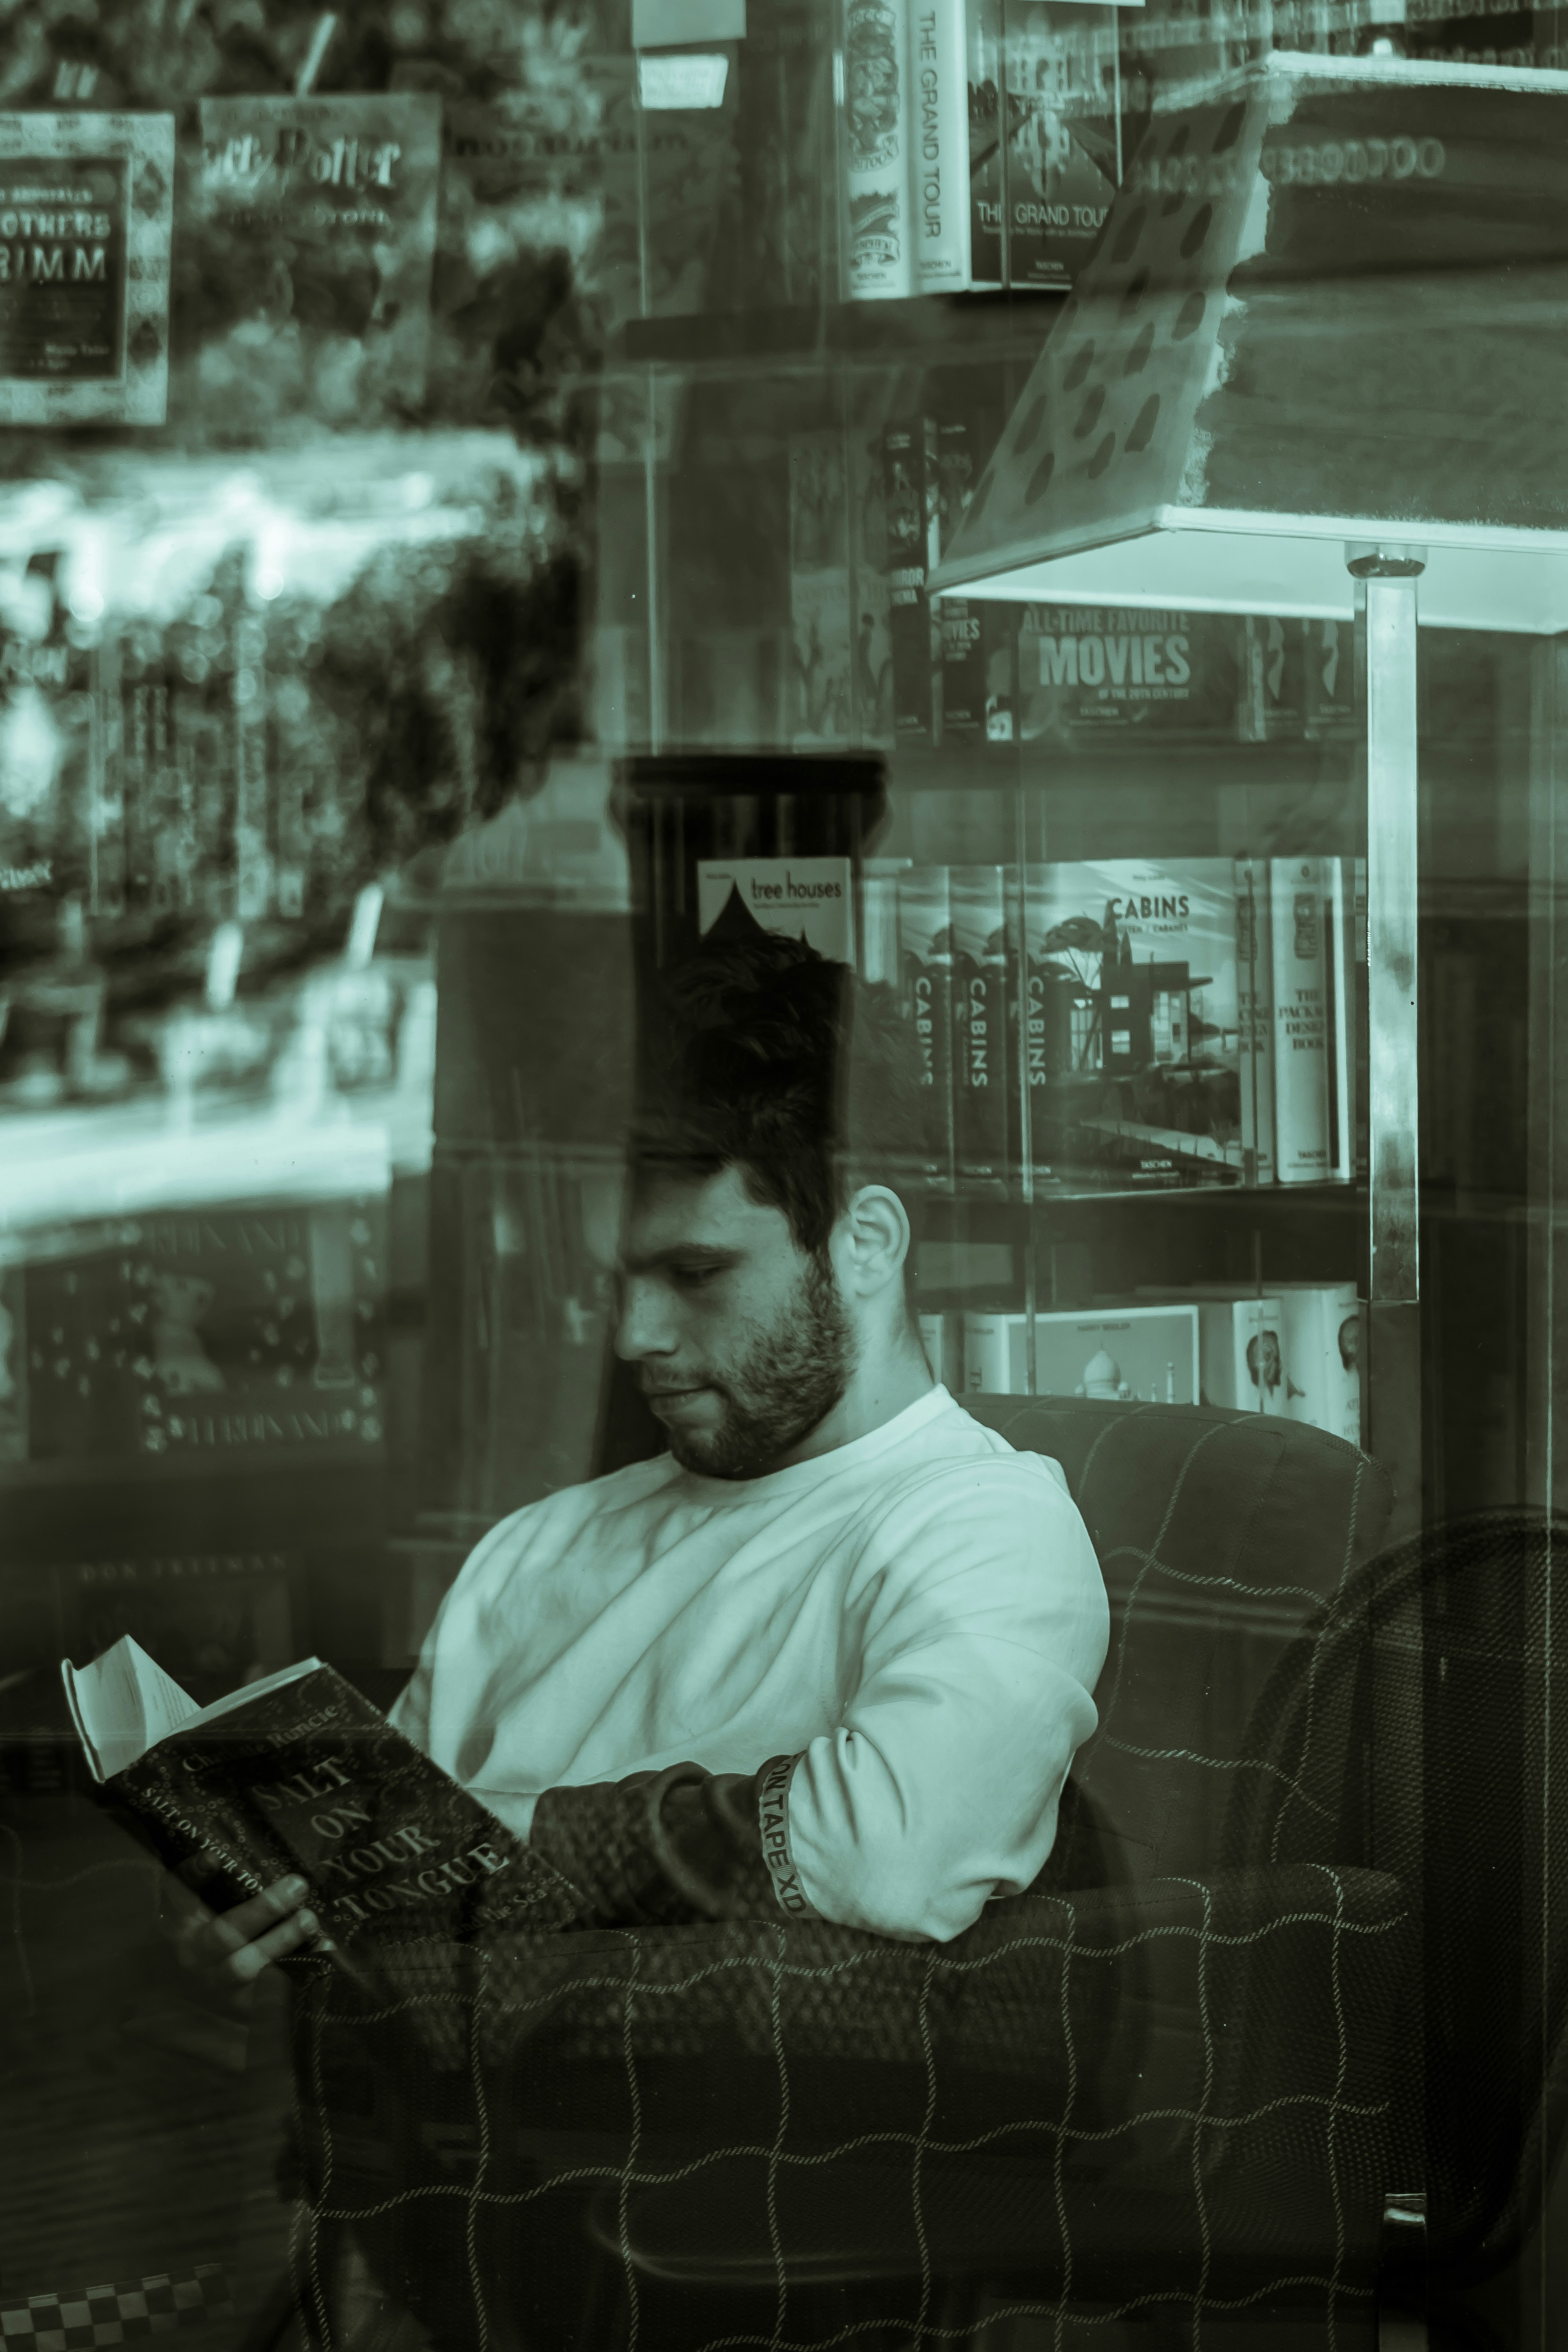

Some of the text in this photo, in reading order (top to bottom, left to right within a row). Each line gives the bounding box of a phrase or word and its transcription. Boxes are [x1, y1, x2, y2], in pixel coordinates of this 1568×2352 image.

[919, 11, 941, 238] THE GRAND TOUR
[1014, 202, 1069, 226] GRAND
[1038, 634, 1191, 687] MOVIES
[751, 870, 842, 899] tree houses
[1112, 895, 1190, 919] CABINS
[970, 976, 988, 1088] CABINS
[1028, 976, 1046, 1086] CABINS
[266, 1704, 339, 1748] Runcie
[253, 1756, 351, 1810] SALT
[765, 1763, 791, 1791] ON
[140, 1787, 181, 1819] SALT
[177, 1819, 202, 1839] ON
[311, 1800, 373, 1839] ON
[763, 1794, 790, 1869] TAPE
[322, 1825, 442, 1880] YOUR
[334, 1842, 509, 1921] TONGUE
